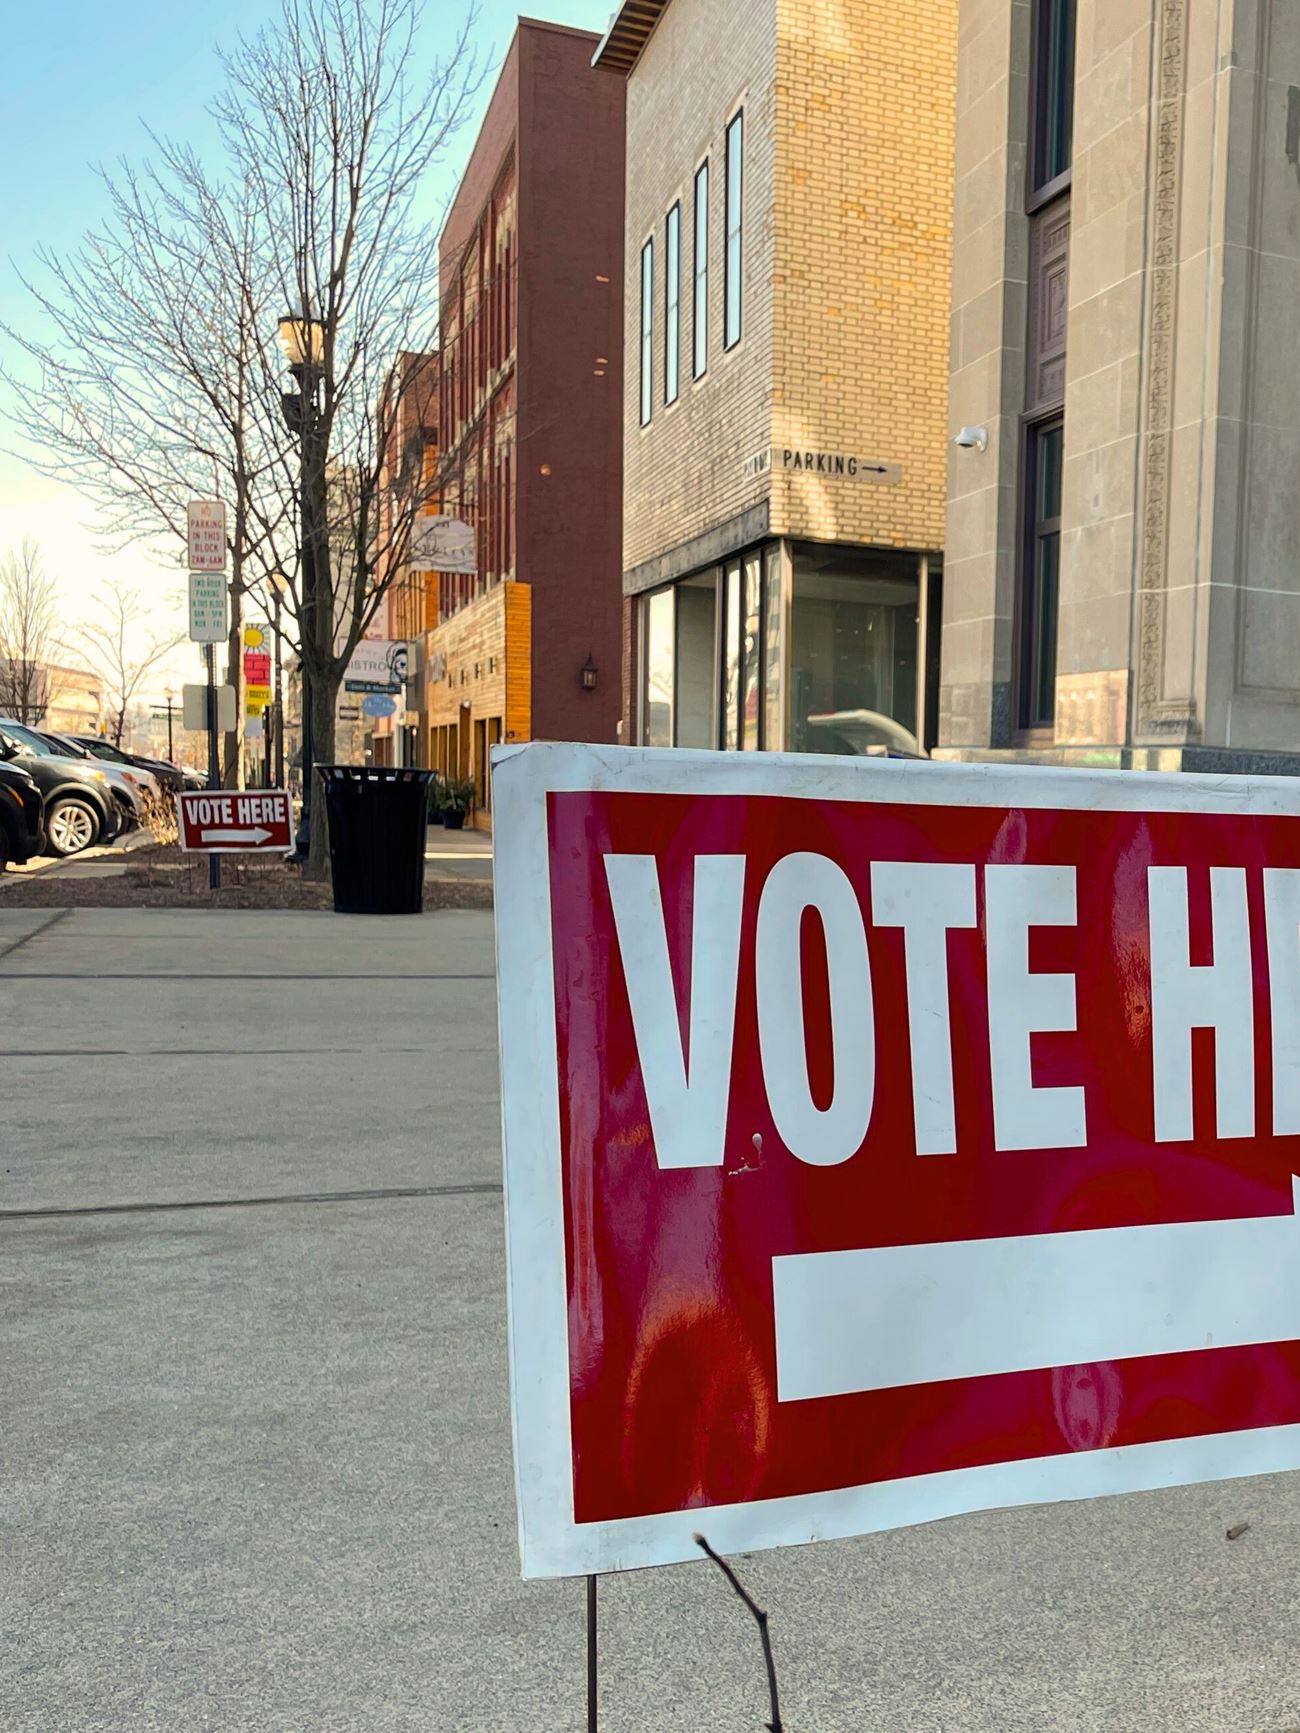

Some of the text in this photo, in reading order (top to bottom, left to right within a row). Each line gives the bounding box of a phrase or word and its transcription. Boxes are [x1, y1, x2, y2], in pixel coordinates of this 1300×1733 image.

[783, 449, 858, 476] PARKING
[190, 519, 223, 528] PARKING
[192, 531, 220, 541] IN THIS
[195, 543, 219, 552] BLOCK
[347, 660, 387, 671] ISTRO
[185, 797, 286, 825] VOTE HERE
[603, 851, 1088, 1169] VOTE
